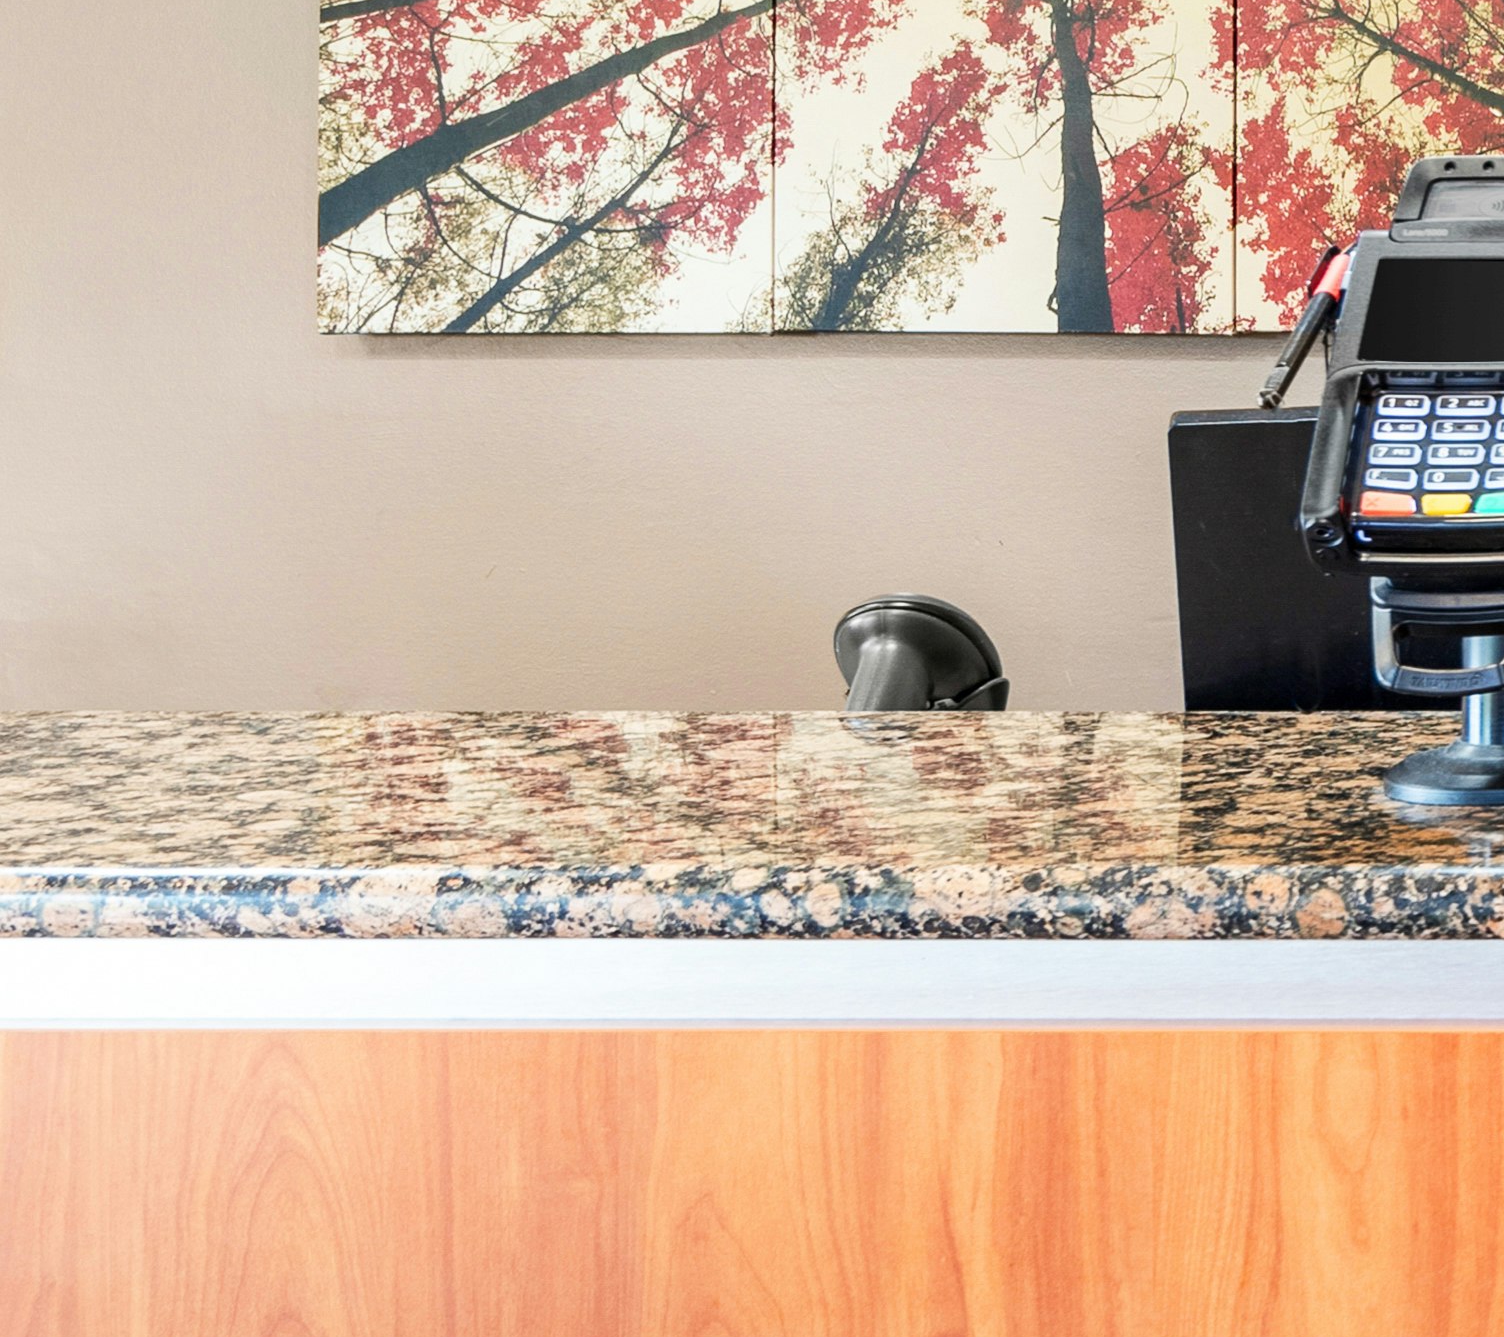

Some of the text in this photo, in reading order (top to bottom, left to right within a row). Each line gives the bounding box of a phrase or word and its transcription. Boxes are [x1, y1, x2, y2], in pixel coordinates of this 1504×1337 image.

[1387, 398, 1396, 408] 1
[1447, 398, 1458, 408] 2
[1380, 422, 1393, 433] 4
[1443, 422, 1454, 433] 5
[1377, 446, 1389, 458] 7
[1437, 447, 1450, 458] 8
[1433, 471, 1445, 483] 0
